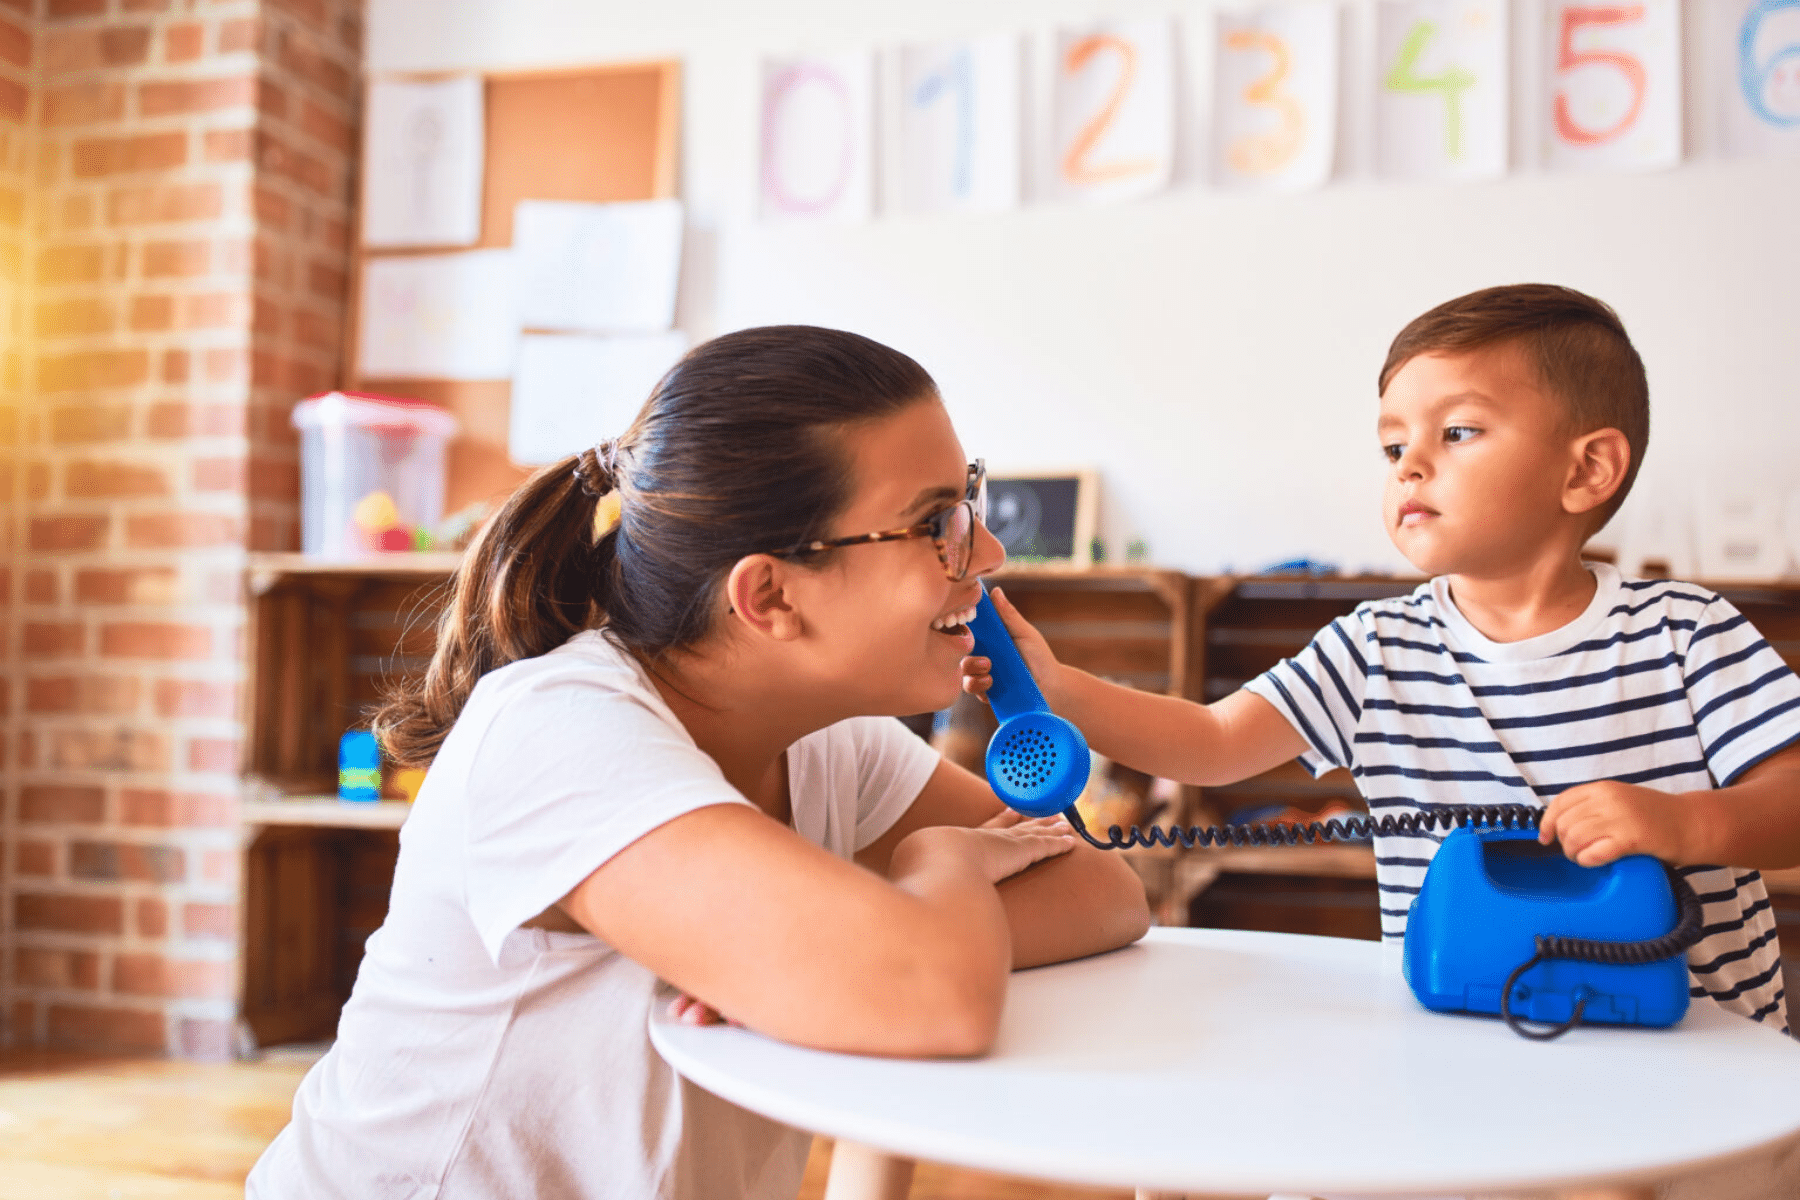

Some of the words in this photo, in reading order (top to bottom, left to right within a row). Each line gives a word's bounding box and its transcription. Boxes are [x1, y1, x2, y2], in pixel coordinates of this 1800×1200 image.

[761, 61, 854, 219] 0
[914, 47, 974, 197] 1
[1063, 34, 1158, 184] 2
[1224, 30, 1306, 176] 3
[1385, 20, 1477, 163] 4
[1552, 4, 1646, 146] 5
